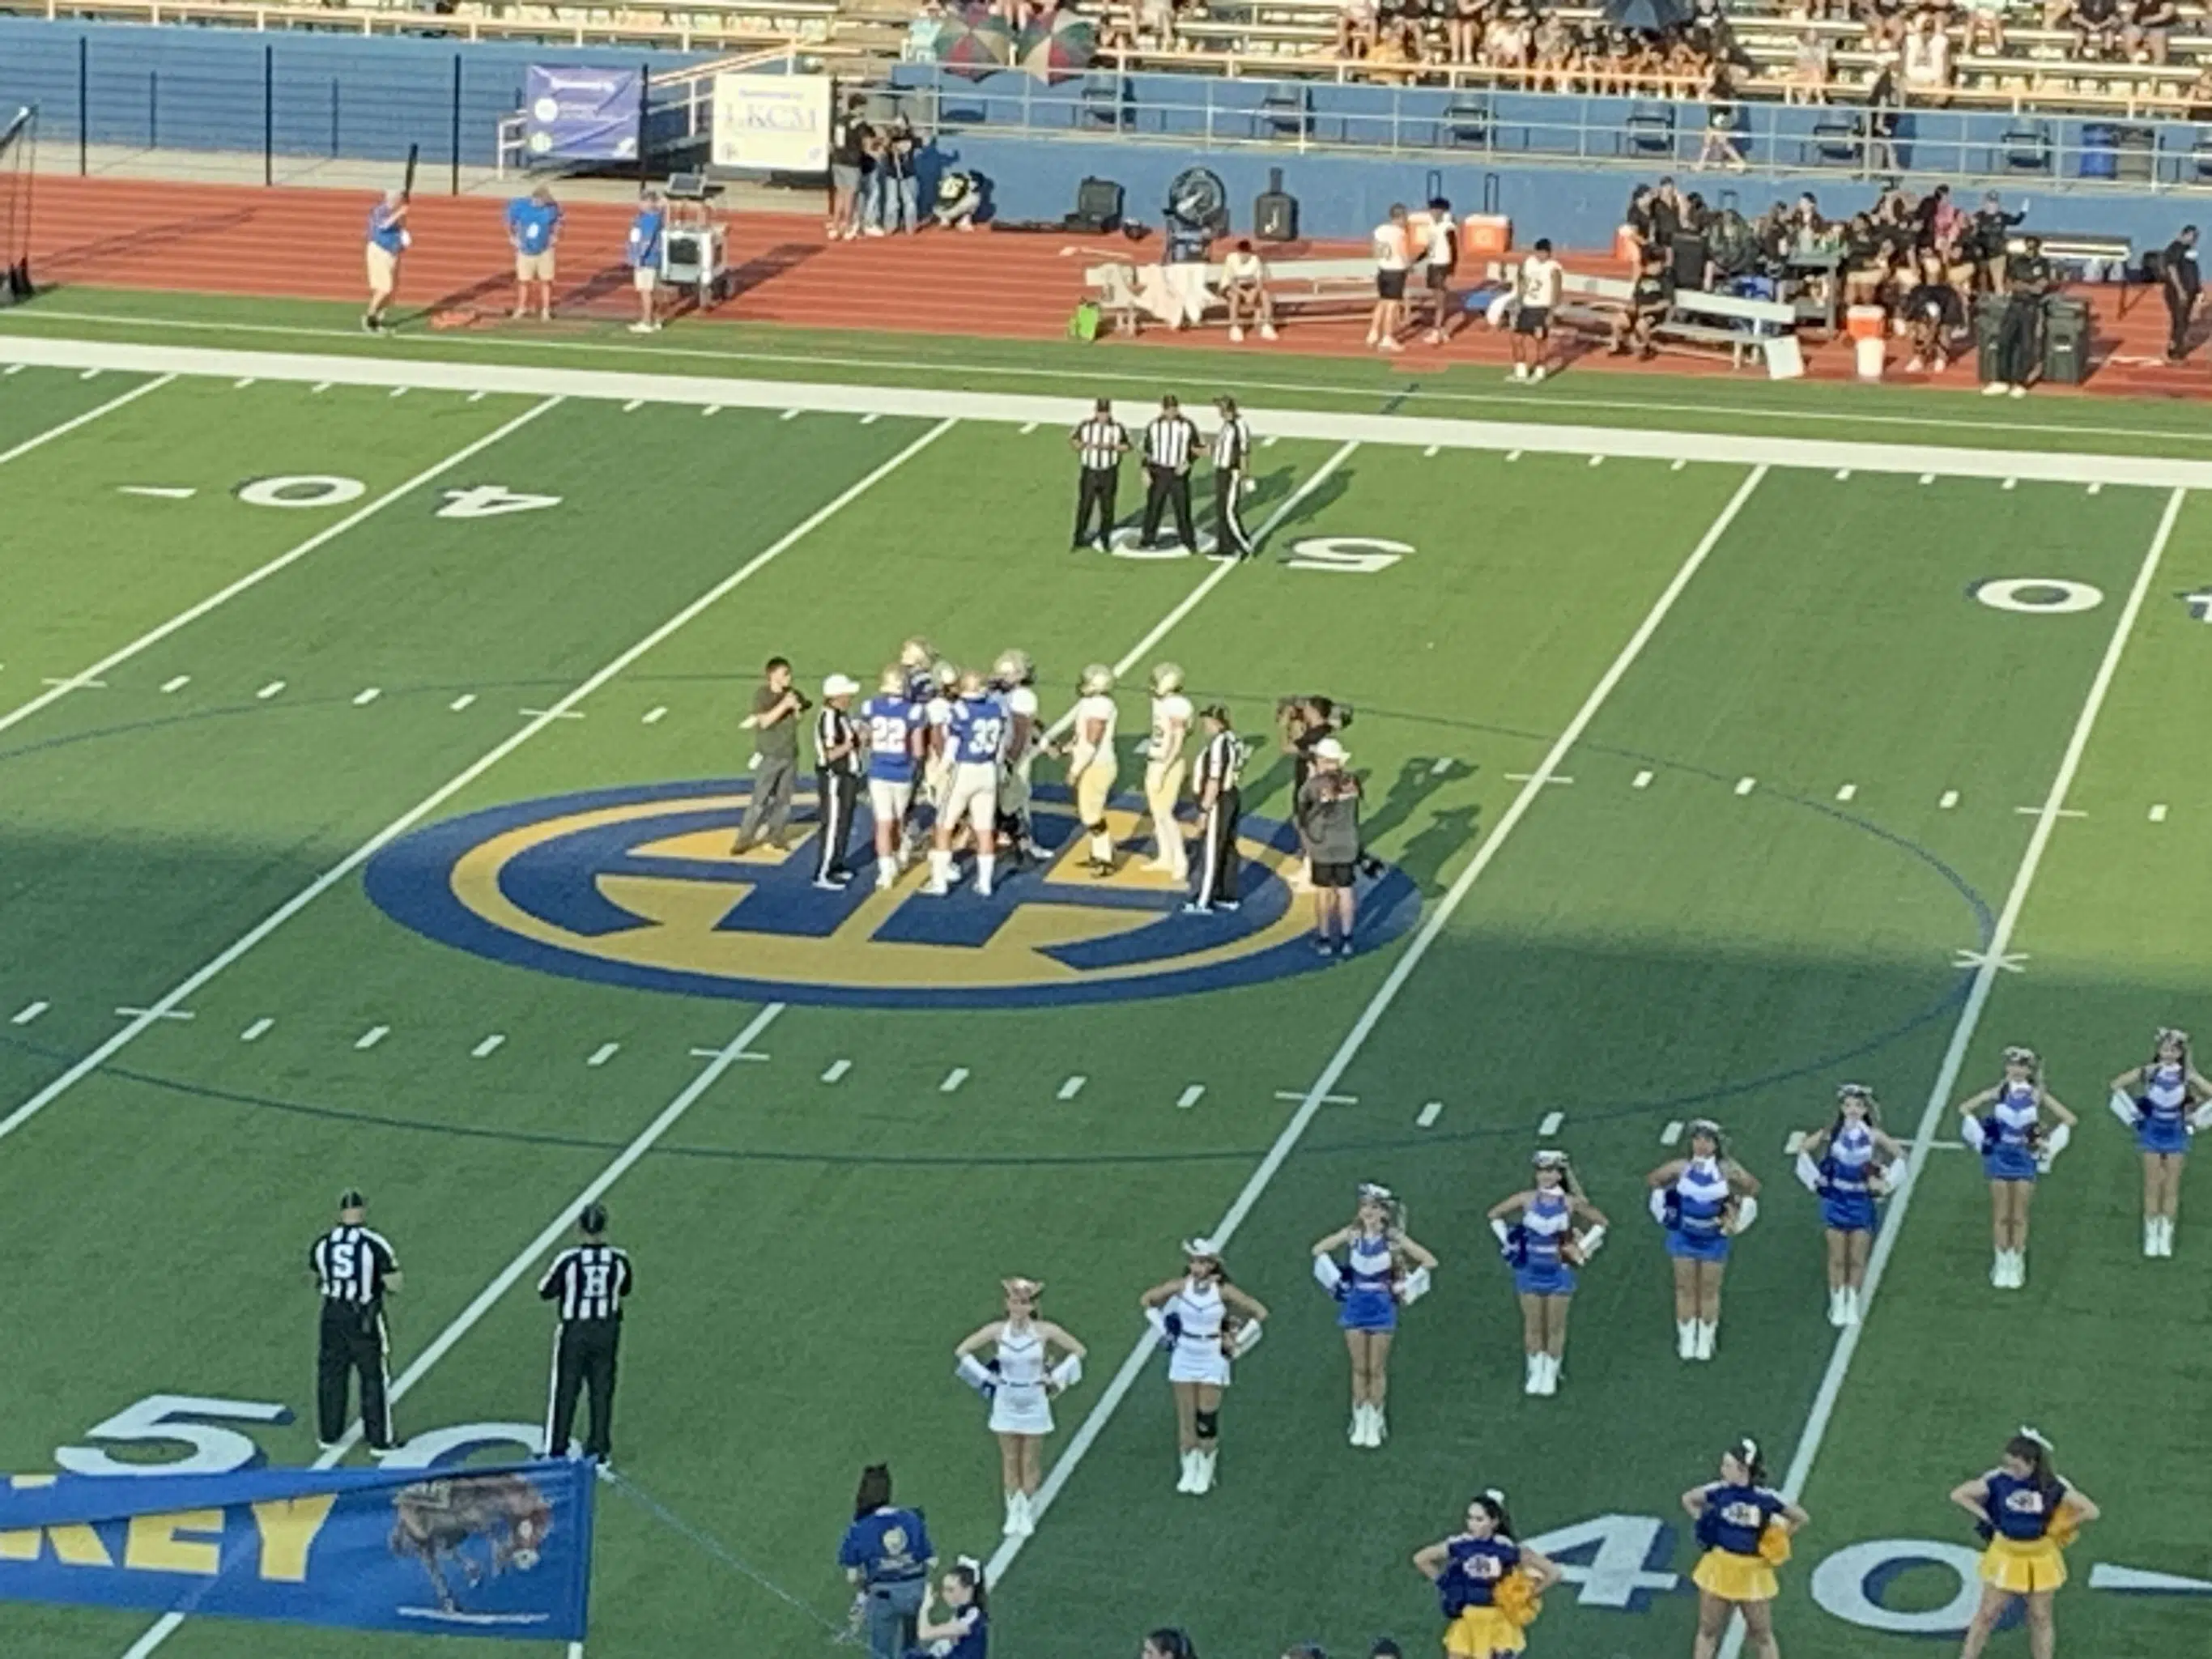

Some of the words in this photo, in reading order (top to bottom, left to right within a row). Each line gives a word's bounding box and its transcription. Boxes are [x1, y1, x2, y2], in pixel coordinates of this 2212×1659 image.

[870, 716, 907, 753] 22
[968, 718, 1002, 754] 33
[331, 1244, 355, 1278] S
[581, 1266, 611, 1298] H
